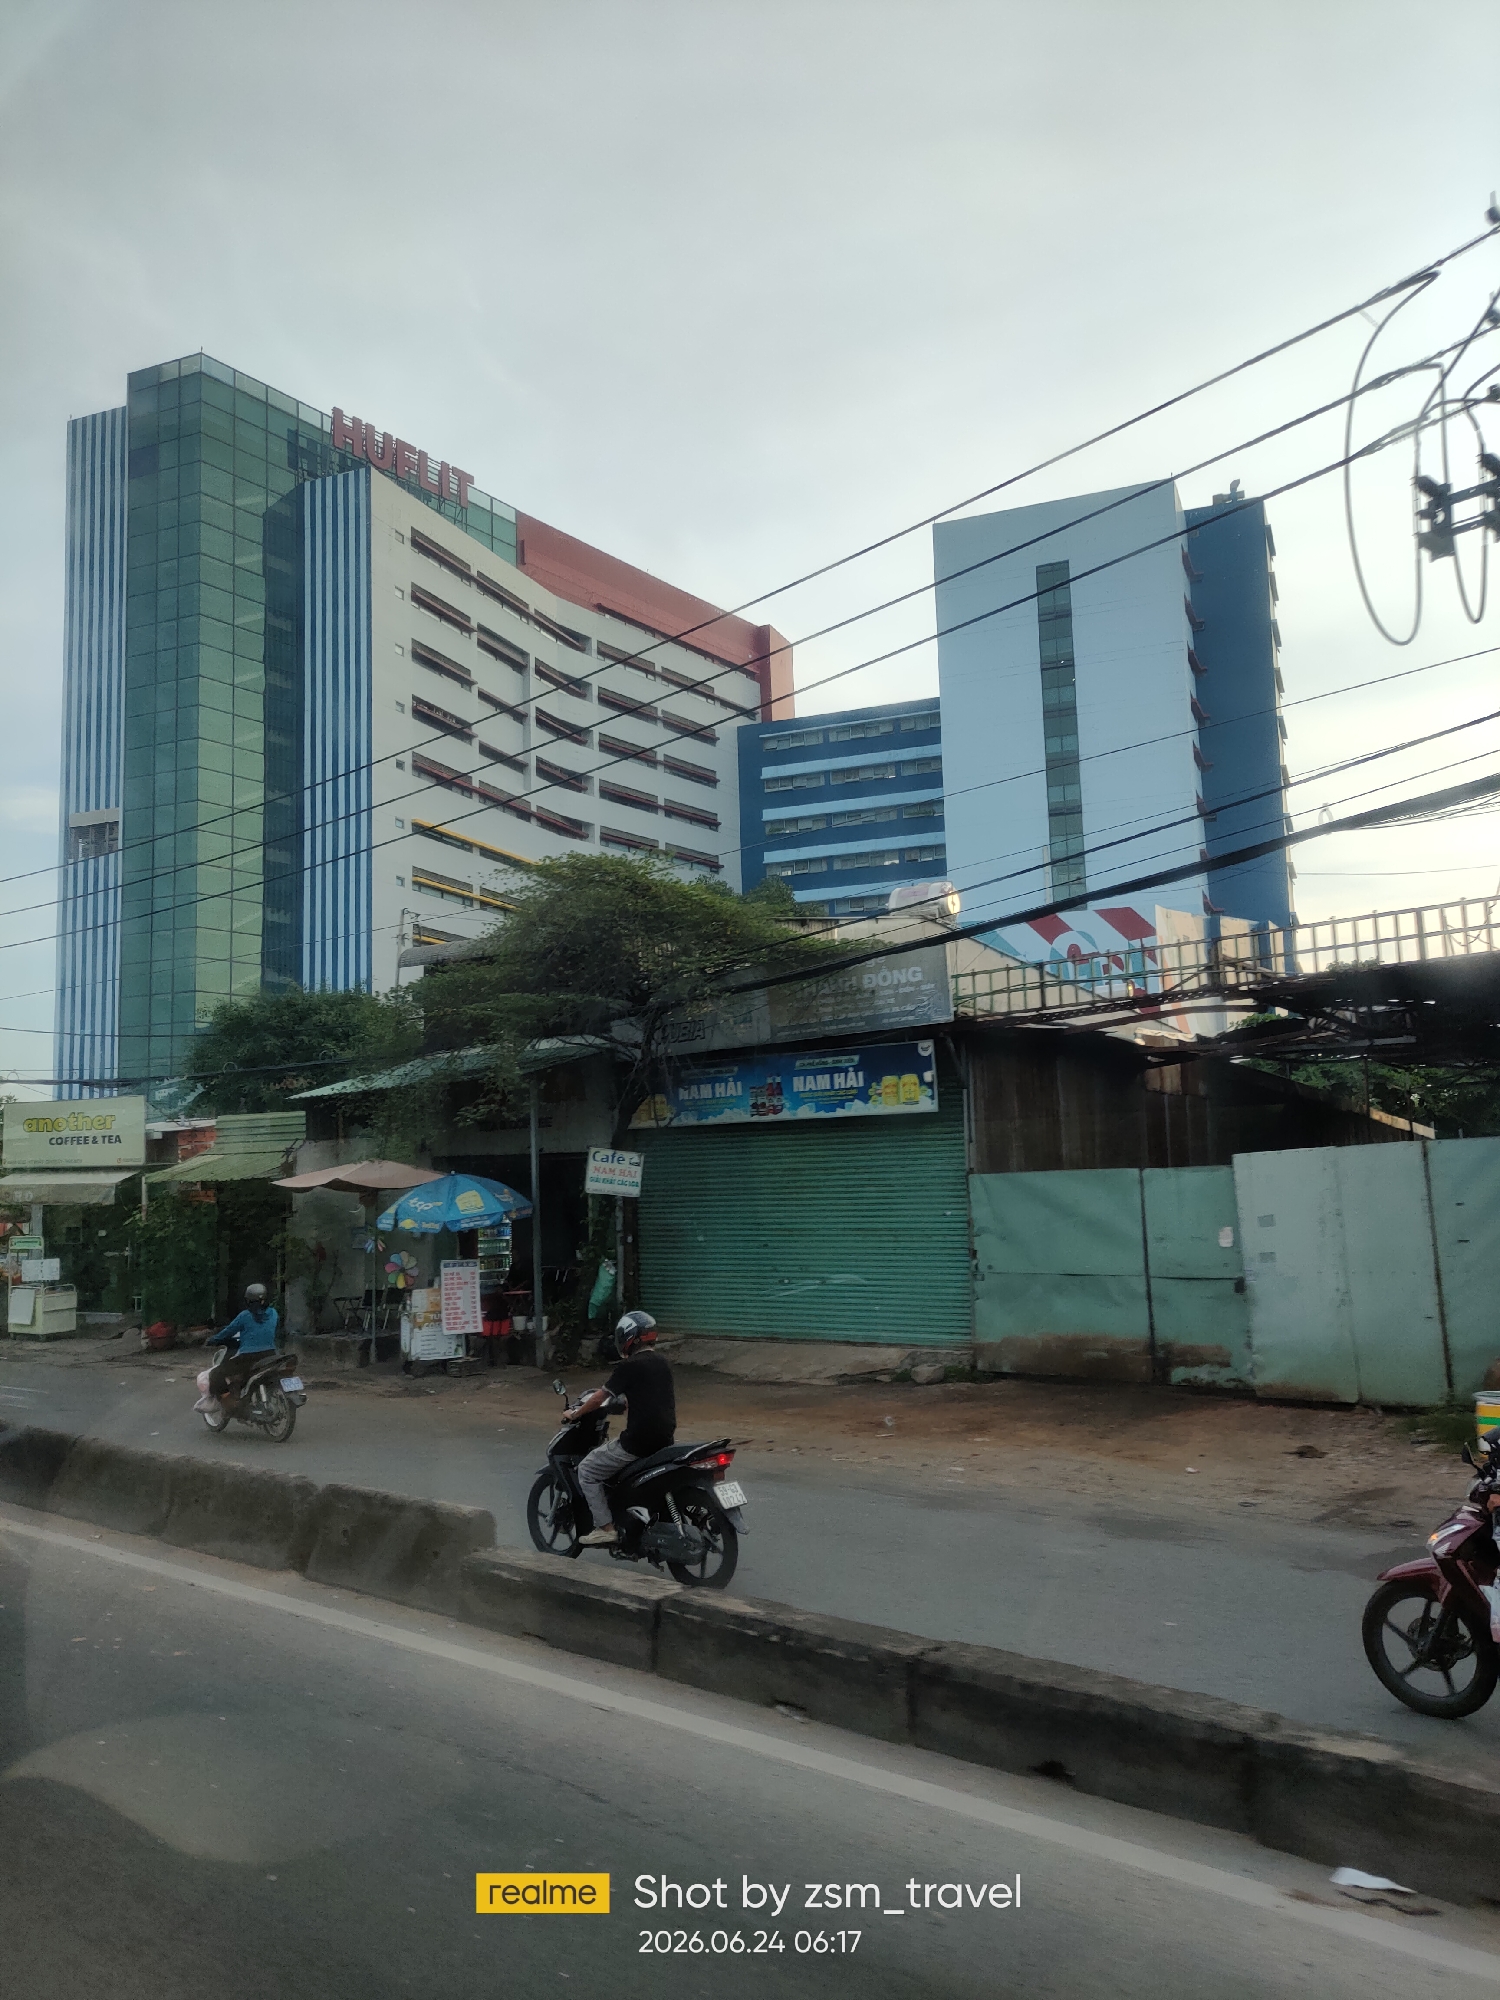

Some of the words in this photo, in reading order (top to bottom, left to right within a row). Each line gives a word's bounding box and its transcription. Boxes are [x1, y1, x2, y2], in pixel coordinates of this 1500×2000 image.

[331, 406, 475, 509] HUFLIT
[678, 1083, 713, 1101] NAM
[714, 1077, 743, 1098] HẢI
[792, 1074, 831, 1092] NAM
[833, 1067, 864, 1089] HẢI
[23, 1112, 116, 1133] another
[49, 1135, 90, 1146] COFFEE
[91, 1135, 98, 1145] &
[101, 1134, 122, 1145] TEA
[592, 1165, 616, 1176] NAM
